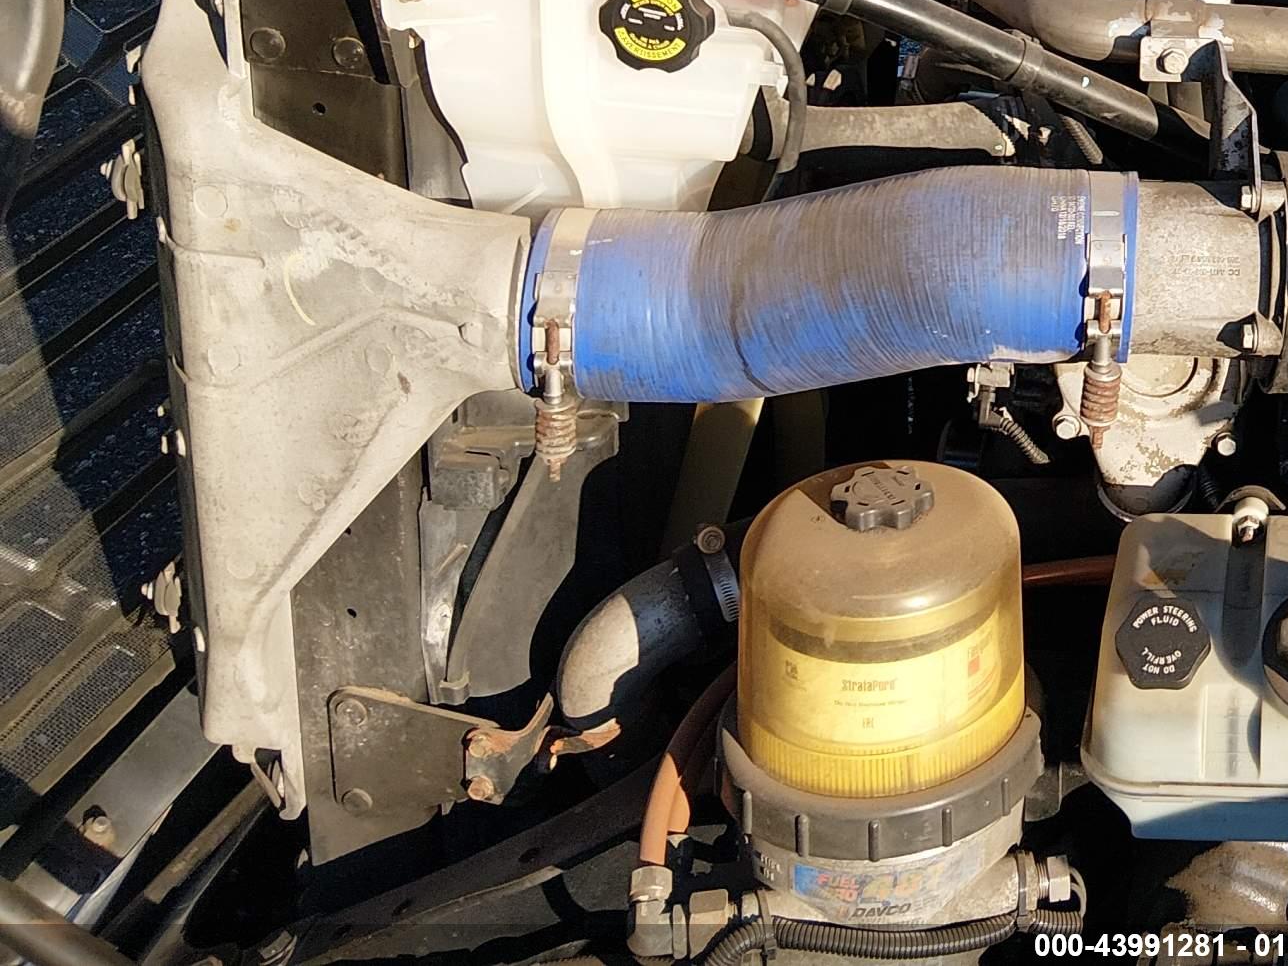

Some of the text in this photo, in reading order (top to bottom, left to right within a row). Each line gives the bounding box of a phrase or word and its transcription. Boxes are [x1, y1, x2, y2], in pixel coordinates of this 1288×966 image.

[620, 35, 682, 58] AVERTISSEMENT
[1132, 605, 1198, 633] POWER STEERING
[1150, 615, 1180, 627] FLUID
[1141, 646, 1182, 665] OVERFILL
[1141, 663, 1175, 675] DO NOT
[816, 872, 859, 890] FUEL
[851, 903, 912, 918] DAVCO
